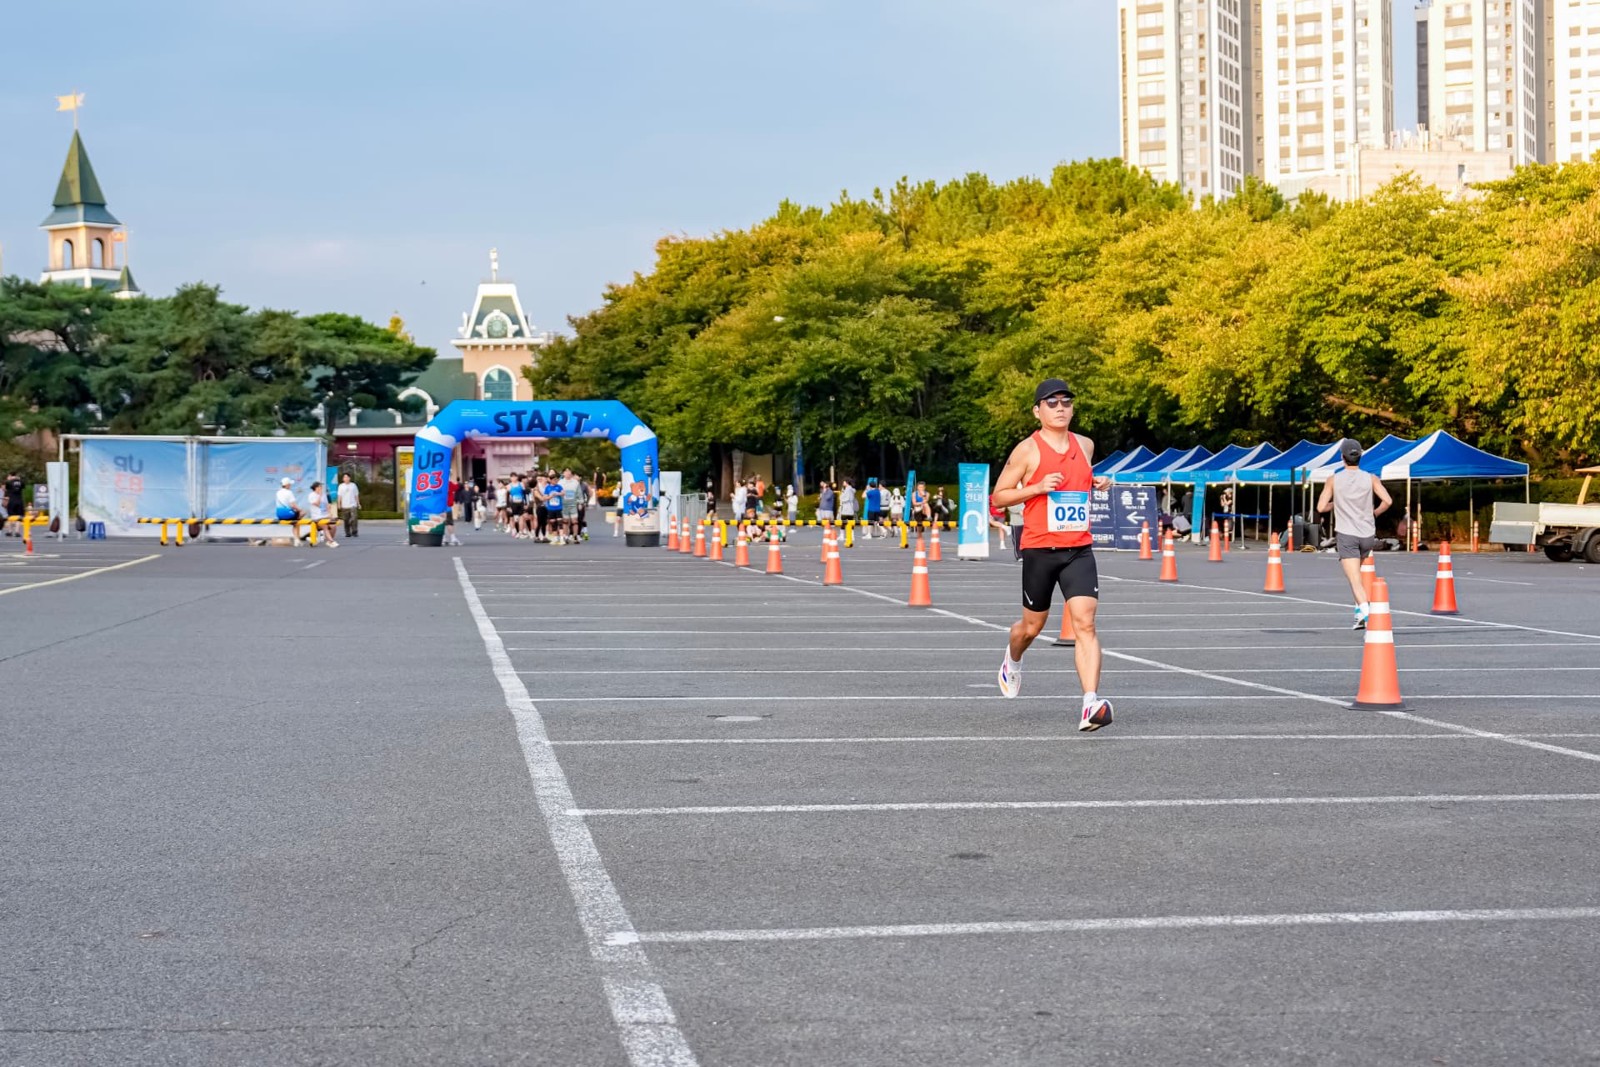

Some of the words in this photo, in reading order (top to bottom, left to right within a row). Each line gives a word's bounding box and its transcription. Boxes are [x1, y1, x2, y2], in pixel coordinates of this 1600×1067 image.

[493, 409, 591, 434] START
[418, 450, 445, 470] UP
[416, 470, 443, 492] 83
[1055, 506, 1086, 522] 026
